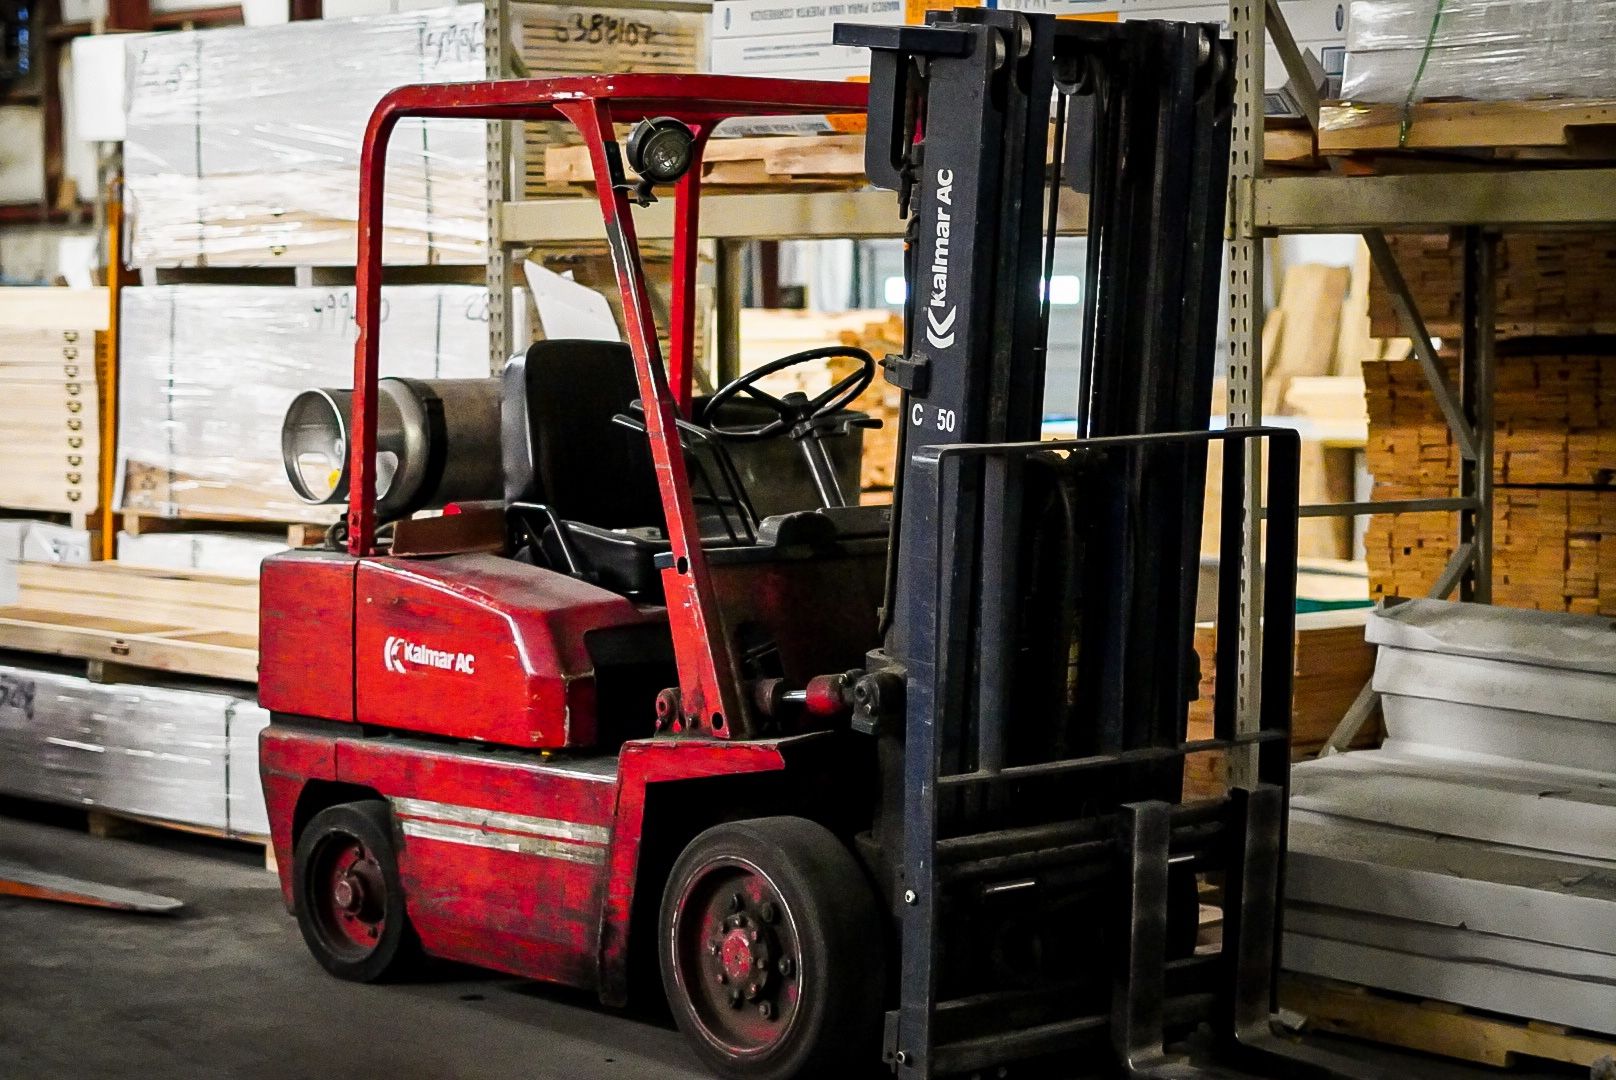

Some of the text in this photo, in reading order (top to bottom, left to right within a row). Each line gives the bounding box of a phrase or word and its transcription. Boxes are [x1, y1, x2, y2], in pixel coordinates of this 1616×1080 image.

[930, 168, 954, 308] Kalmar AC
[912, 403, 955, 432] C 50
[404, 642, 475, 675] Kalmar AC
